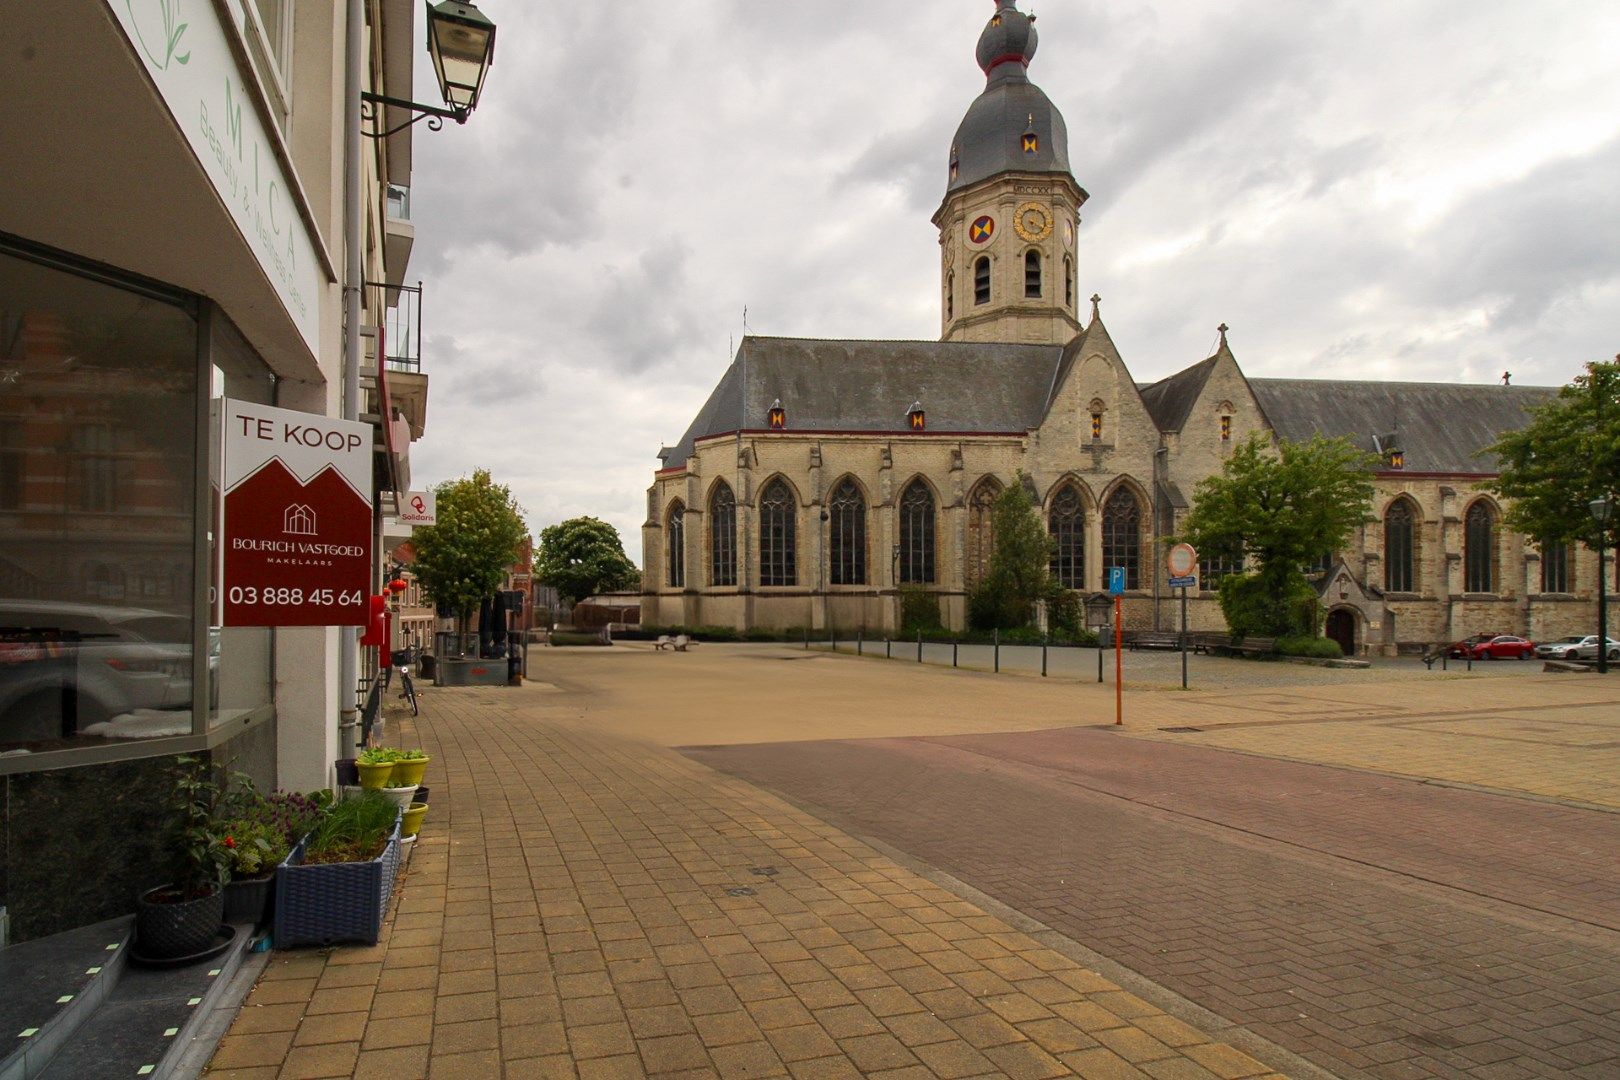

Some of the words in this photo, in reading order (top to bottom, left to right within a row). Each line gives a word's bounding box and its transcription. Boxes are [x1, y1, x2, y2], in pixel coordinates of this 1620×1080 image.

[200, 99, 238, 198] Beauty
[243, 185, 250, 212] &
[236, 415, 274, 441] TE
[284, 423, 362, 452] KOOP
[401, 513, 435, 522] Solidaris
[232, 538, 295, 553] BOURICH
[298, 542, 364, 557] VASTGOED
[267, 557, 333, 566] MAKELAARS
[1113, 570, 1121, 584] P
[229, 586, 257, 605] 03
[262, 587, 303, 606] 888
[308, 588, 334, 606] 45
[338, 589, 363, 606] 64
